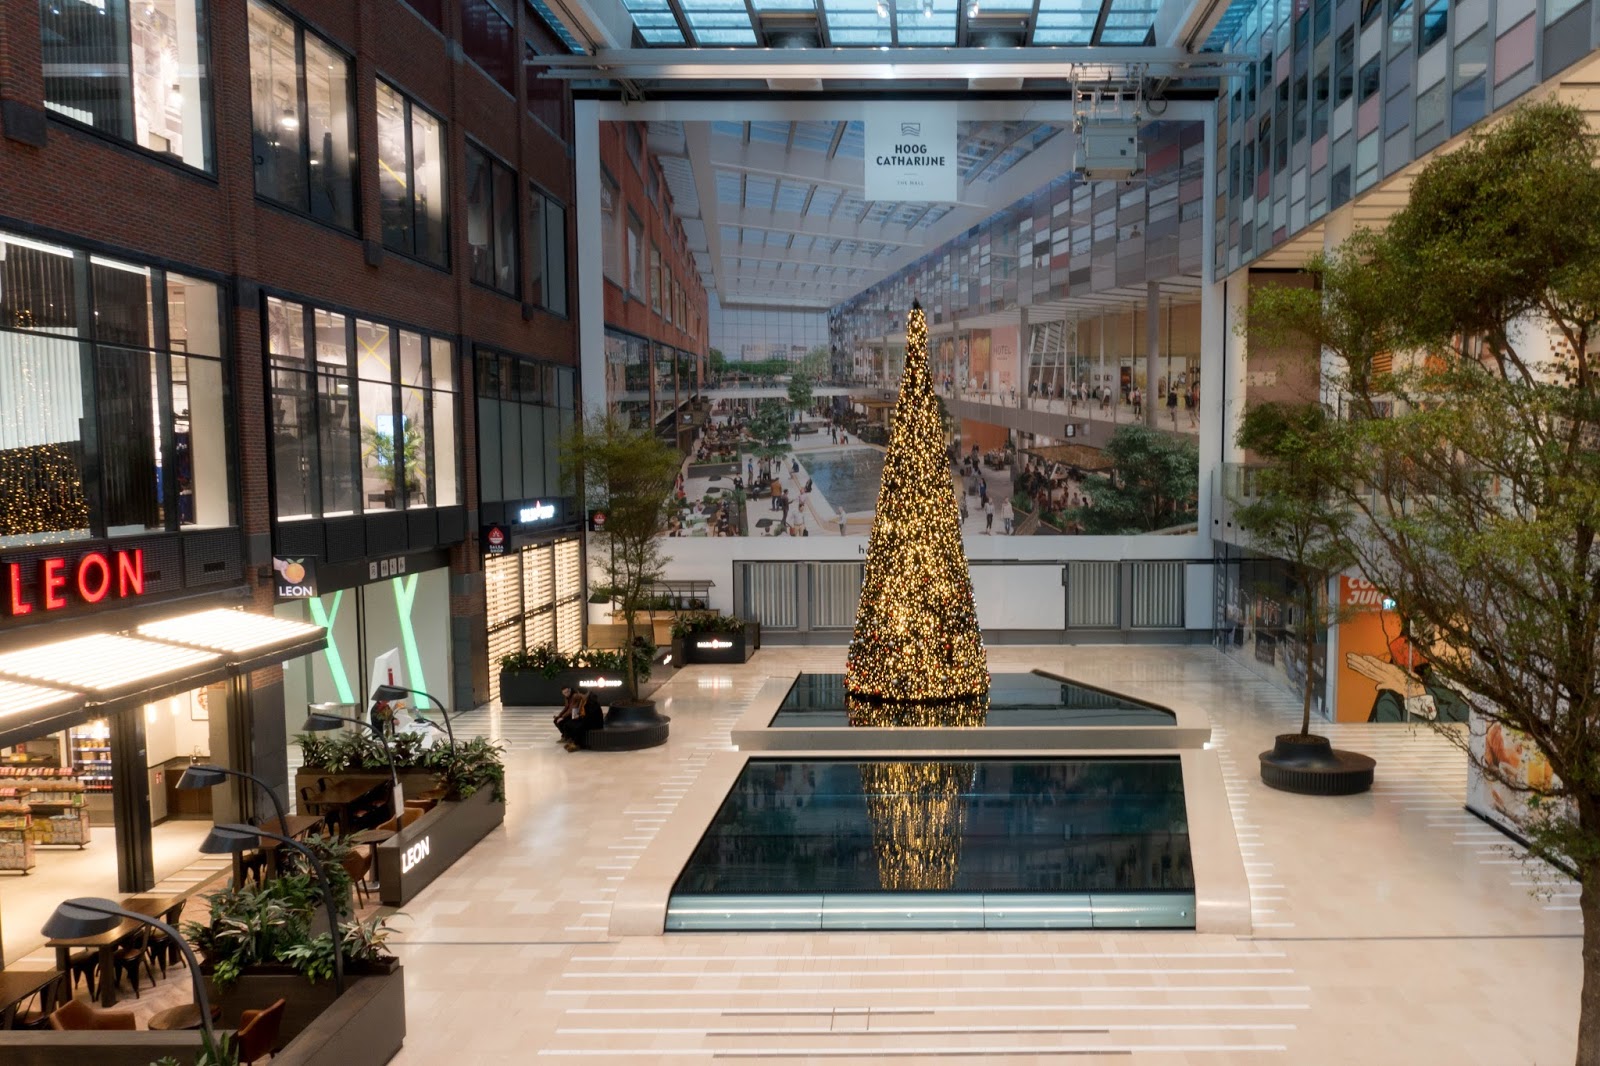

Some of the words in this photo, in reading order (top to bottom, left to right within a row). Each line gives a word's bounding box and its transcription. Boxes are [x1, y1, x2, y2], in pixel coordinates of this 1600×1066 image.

[895, 144, 927, 154] HOOG
[876, 156, 945, 166] CATHARIJNE
[10, 548, 144, 616] LEON
[278, 585, 313, 597] LEON
[401, 835, 430, 874] LEON
